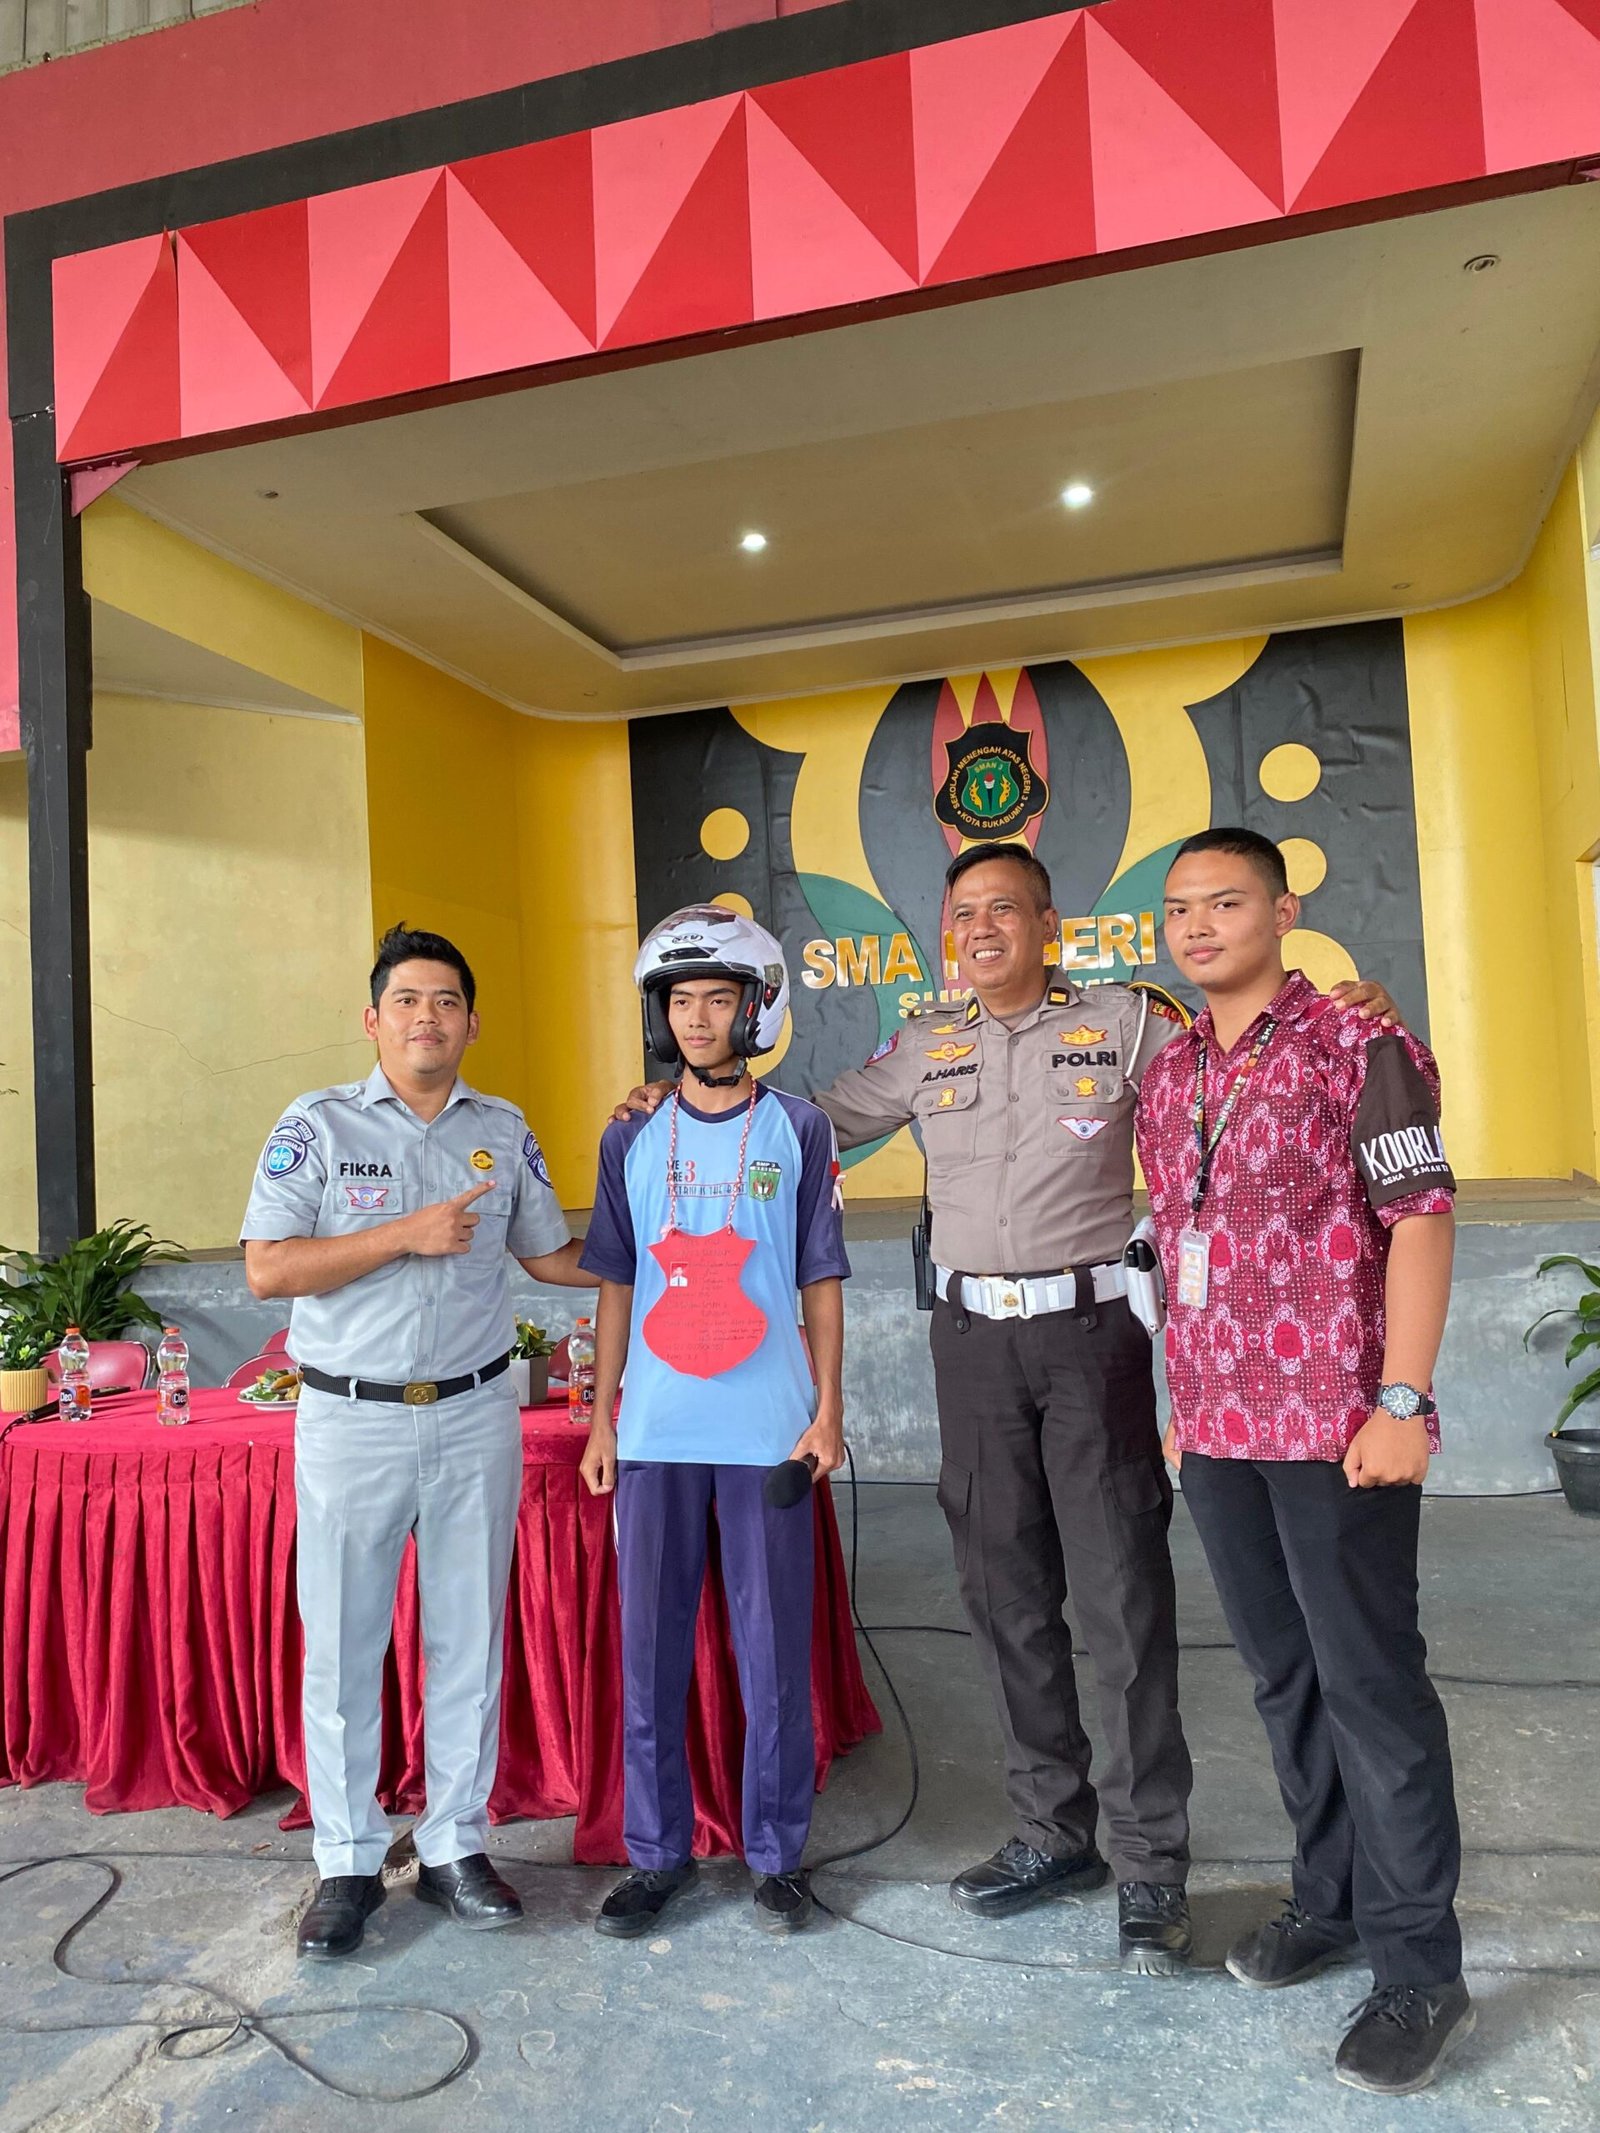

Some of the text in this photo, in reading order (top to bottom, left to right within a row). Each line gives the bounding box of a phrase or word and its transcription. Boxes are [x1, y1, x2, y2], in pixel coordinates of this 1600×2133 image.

[949, 769, 960, 809] SEKOLAH
[958, 746, 1001, 770] MENENGAH
[1002, 748, 1021, 764] ATAS
[1018, 762, 1031, 794] NEGERI
[960, 805, 1022, 828] KOTA SUKABUMI
[800, 912, 1156, 990] SMA ERI
[1262, 1022, 1276, 1041] SMA
[1052, 1050, 1117, 1068] POLRI
[921, 1064, 978, 1084] A.HARIS
[340, 1162, 392, 1178] FIKRA
[684, 1160, 696, 1182] 3
[1382, 1173, 1406, 1186] OSKA
[582, 1390, 594, 1400] Cle
